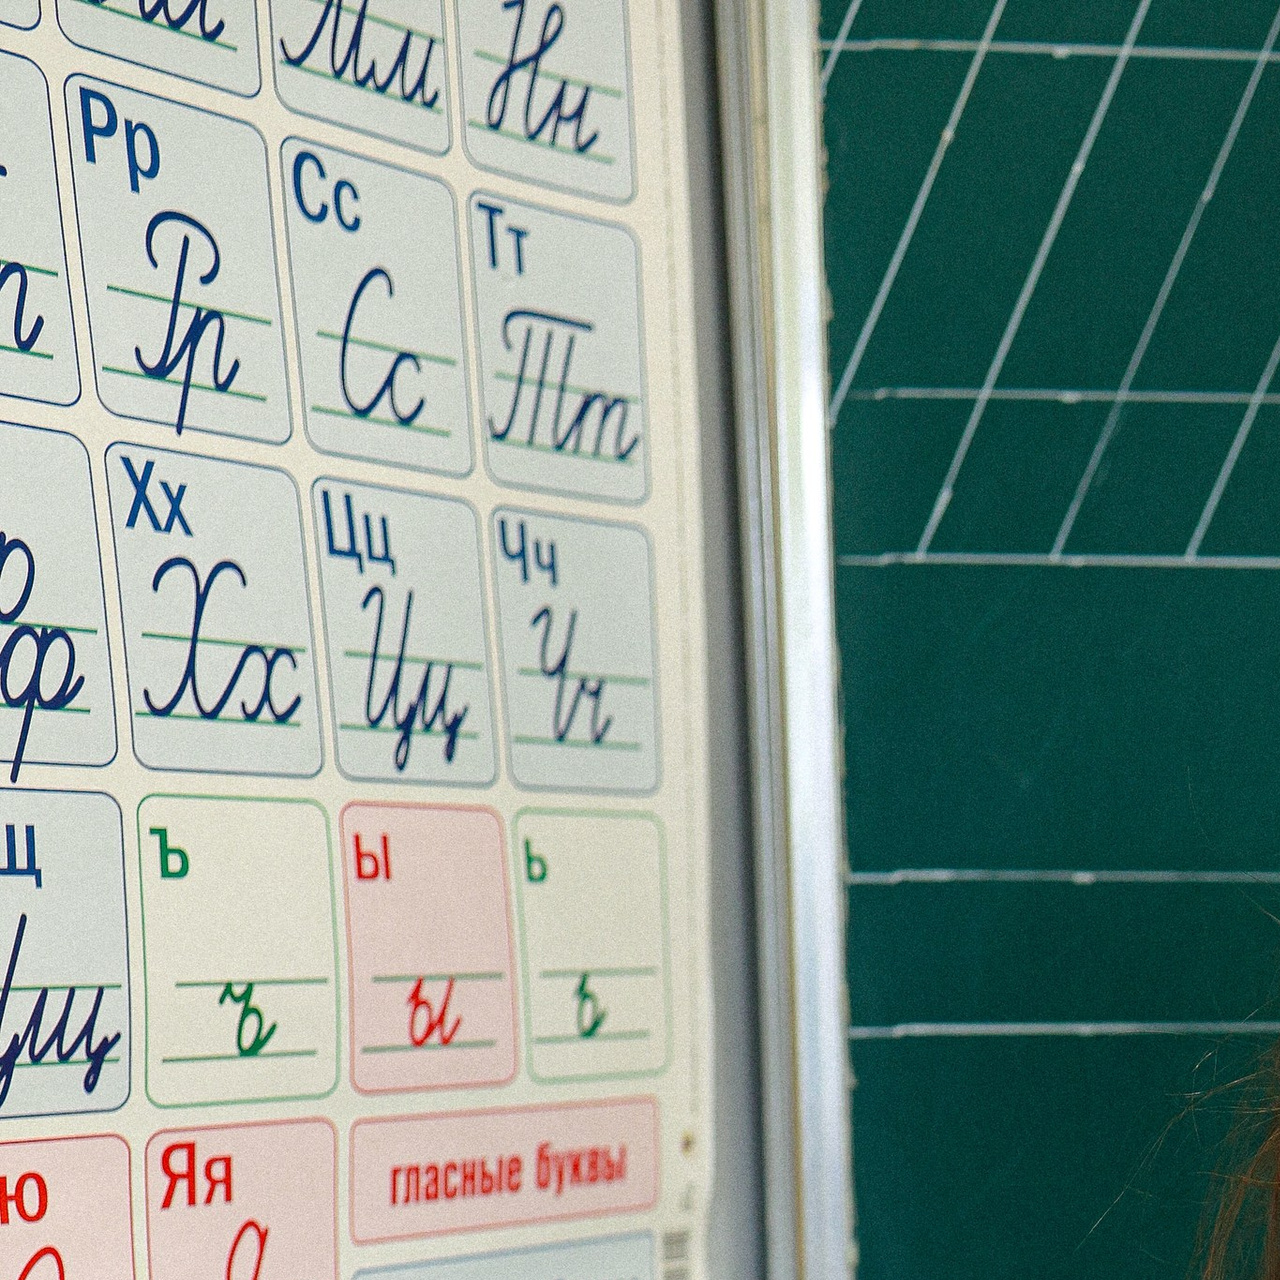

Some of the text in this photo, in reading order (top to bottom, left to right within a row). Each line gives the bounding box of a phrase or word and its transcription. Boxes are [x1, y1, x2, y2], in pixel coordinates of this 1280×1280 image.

[488, 2, 598, 154] Нн
[79, 87, 161, 194] Рр
[293, 152, 362, 232] Сс
[478, 203, 530, 275] Тт
[134, 211, 239, 434] Рр
[340, 268, 426, 417] Сс
[489, 310, 639, 461] Тт
[120, 456, 193, 537] Хх
[322, 490, 396, 575] Цц
[500, 519, 559, 587] Чч
[143, 556, 302, 723] Хх
[362, 586, 468, 771] Цц
[161, 1142, 234, 1210] Яя
[390, 1141, 628, 1206] гласные буквы
